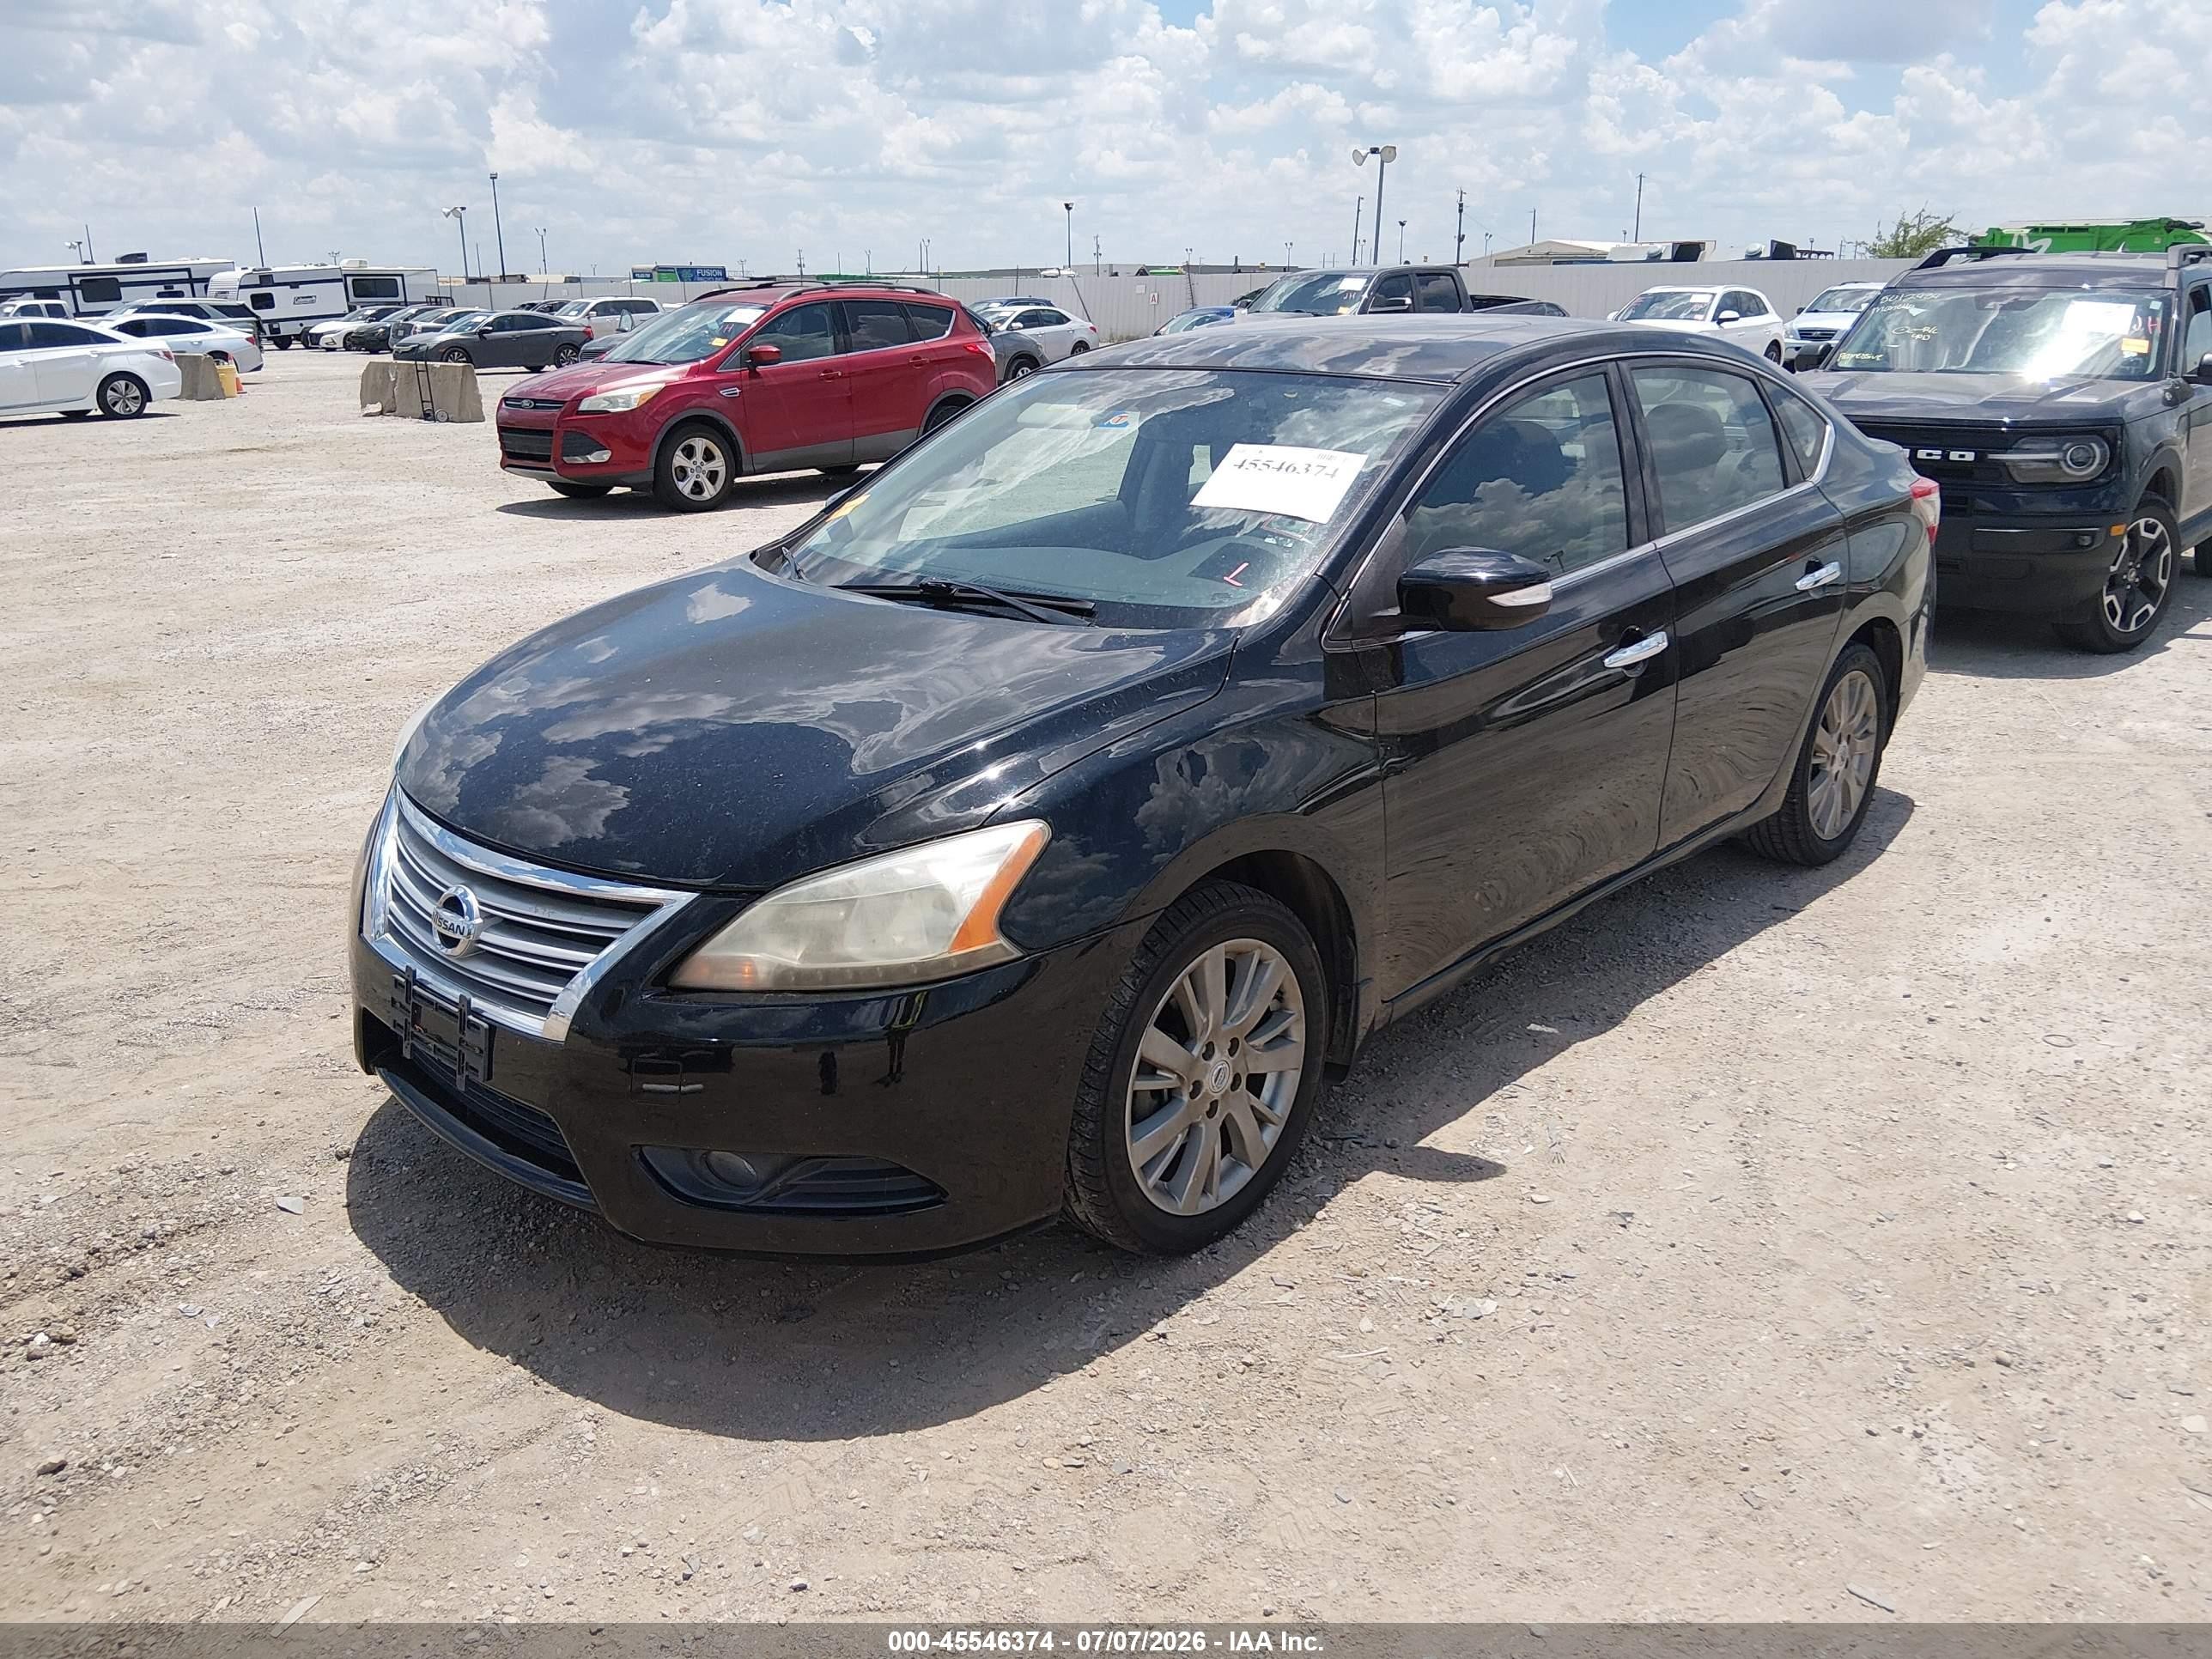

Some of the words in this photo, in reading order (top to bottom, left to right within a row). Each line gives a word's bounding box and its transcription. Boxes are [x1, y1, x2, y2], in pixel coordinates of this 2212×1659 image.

[1151, 294, 1157, 303] A
[1233, 459, 1340, 479] 45546374
[433, 911, 465, 936] NISSAN
